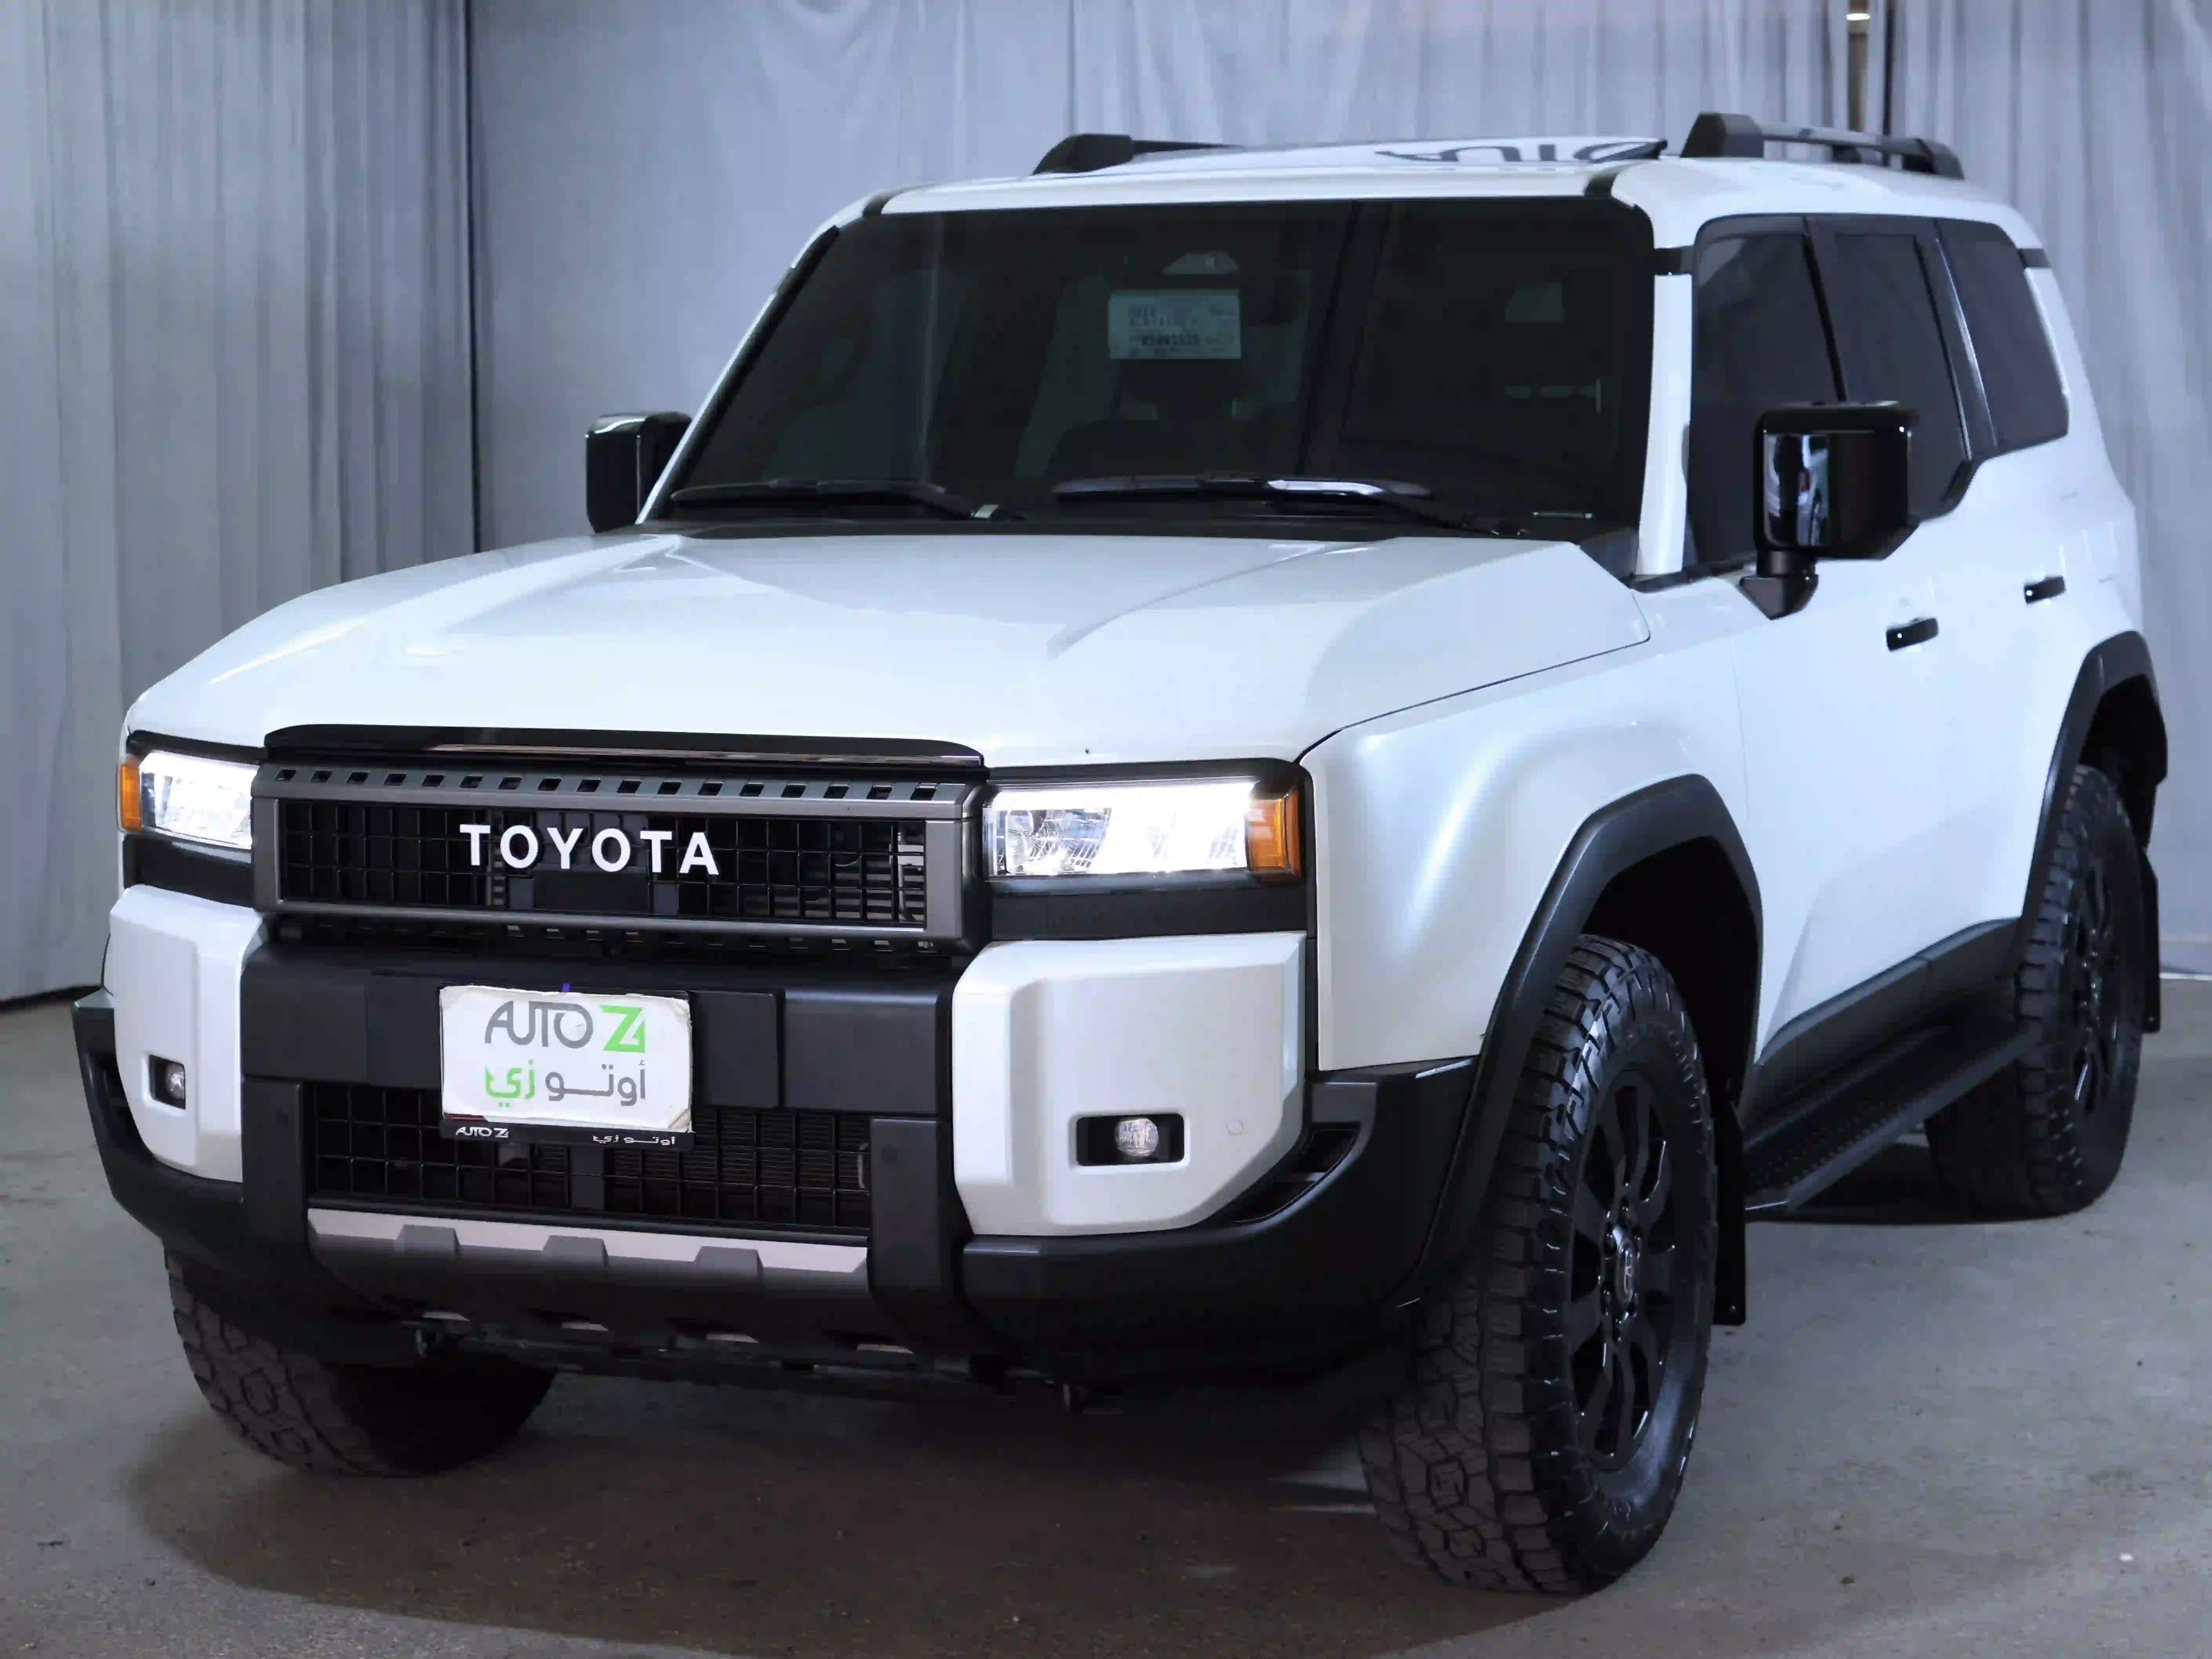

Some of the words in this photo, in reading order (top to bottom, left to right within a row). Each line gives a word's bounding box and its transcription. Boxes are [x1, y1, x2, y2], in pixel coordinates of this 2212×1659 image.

[459, 824, 719, 875] TOYOTA
[484, 1000, 593, 1049] AUTO
[484, 1059, 535, 1107] زي
[455, 1126, 492, 1137] AUTO
